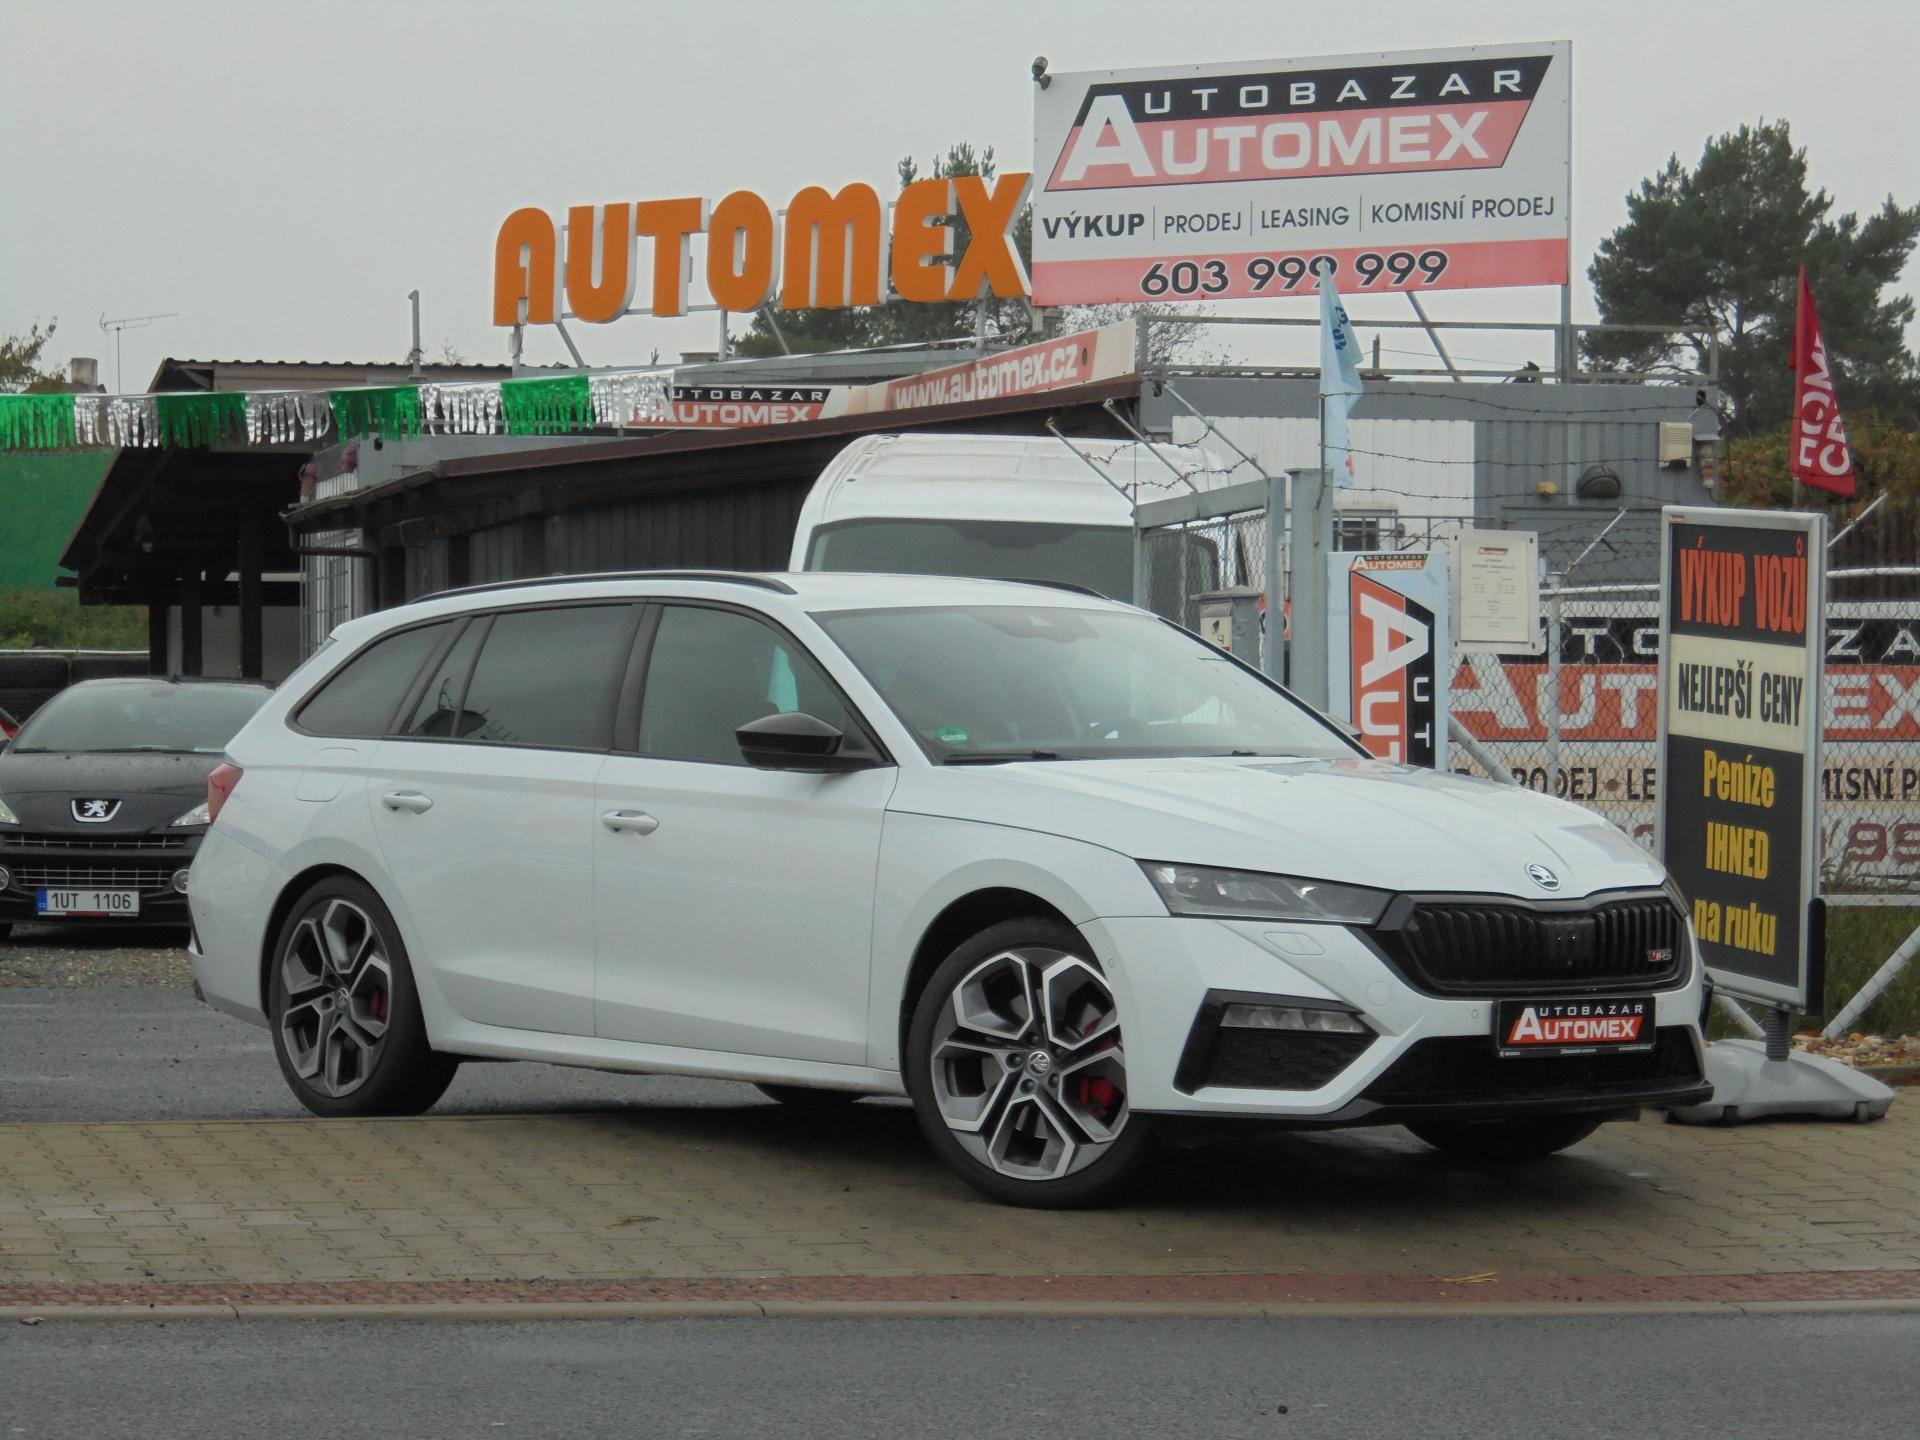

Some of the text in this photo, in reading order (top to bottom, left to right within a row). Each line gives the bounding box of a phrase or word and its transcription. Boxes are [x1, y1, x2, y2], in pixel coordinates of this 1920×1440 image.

[1059, 94, 1489, 182] AUTOMEX
[1042, 194, 1555, 239] VÝKUP PRODEJ LEASING KOMISNÍ PRODEJ
[493, 172, 1033, 326] AUTOMEX
[1141, 260, 1229, 295] 603
[1355, 250, 1448, 286] 999
[896, 344, 1078, 409] www.automex.cz
[1352, 556, 1421, 571] AUTOMEX
[1680, 536, 1806, 634] VÝKUP VOZŮ
[1678, 659, 1803, 727] NEJLEPŠÍ CENY
[1704, 750, 1775, 808] Peníze
[1706, 822, 1769, 880] IHNED
[51, 893, 131, 909] 1UT 1106
[1694, 899, 1776, 956] na ruku
[1513, 1007, 1635, 1041] AUTOMEX
